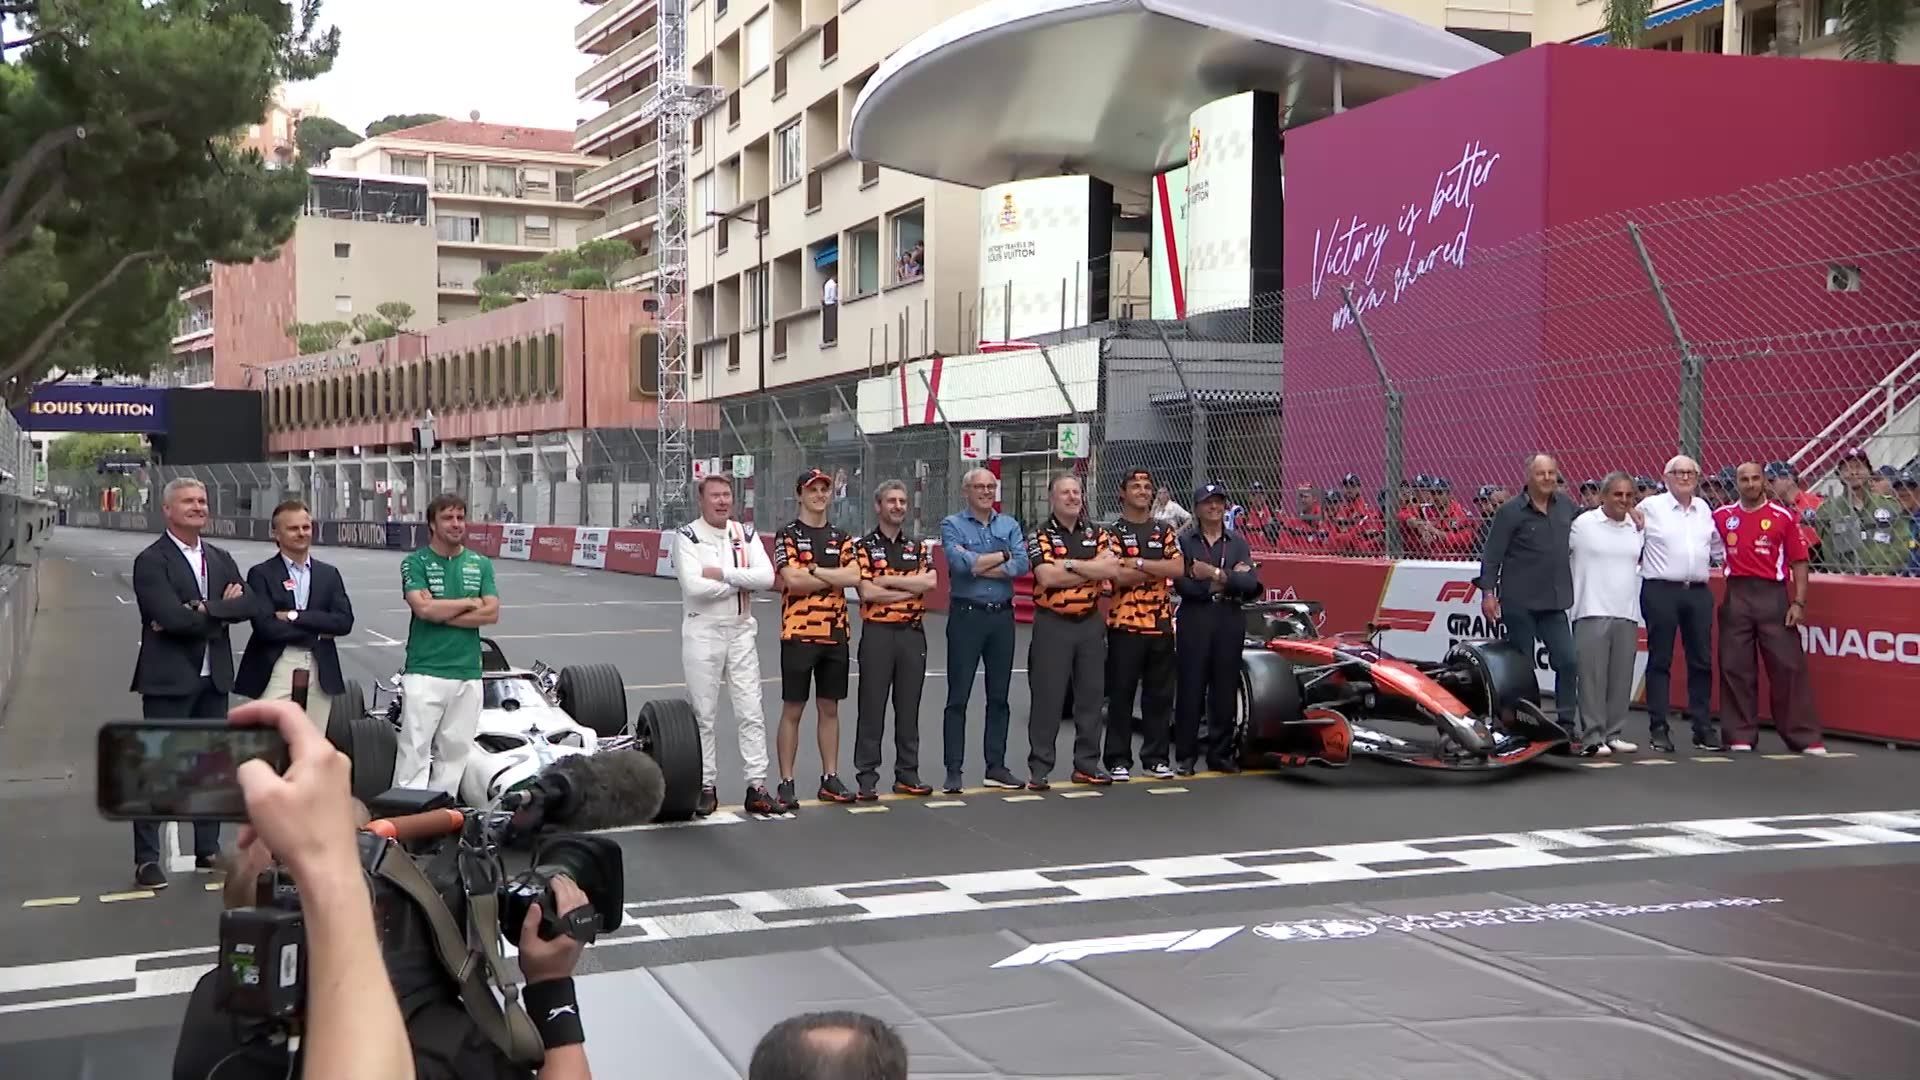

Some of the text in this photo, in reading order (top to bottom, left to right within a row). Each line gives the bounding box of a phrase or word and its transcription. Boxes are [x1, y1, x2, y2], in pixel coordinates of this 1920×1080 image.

[1312, 140, 1500, 300] Victory is better
[1004, 249, 1035, 260] VUITTON
[1394, 203, 1475, 304] shared
[35, 401, 154, 416] LOUIS VUITTON
[337, 523, 387, 545] LOUIS VUITTON
[1435, 580, 1479, 604] F1
